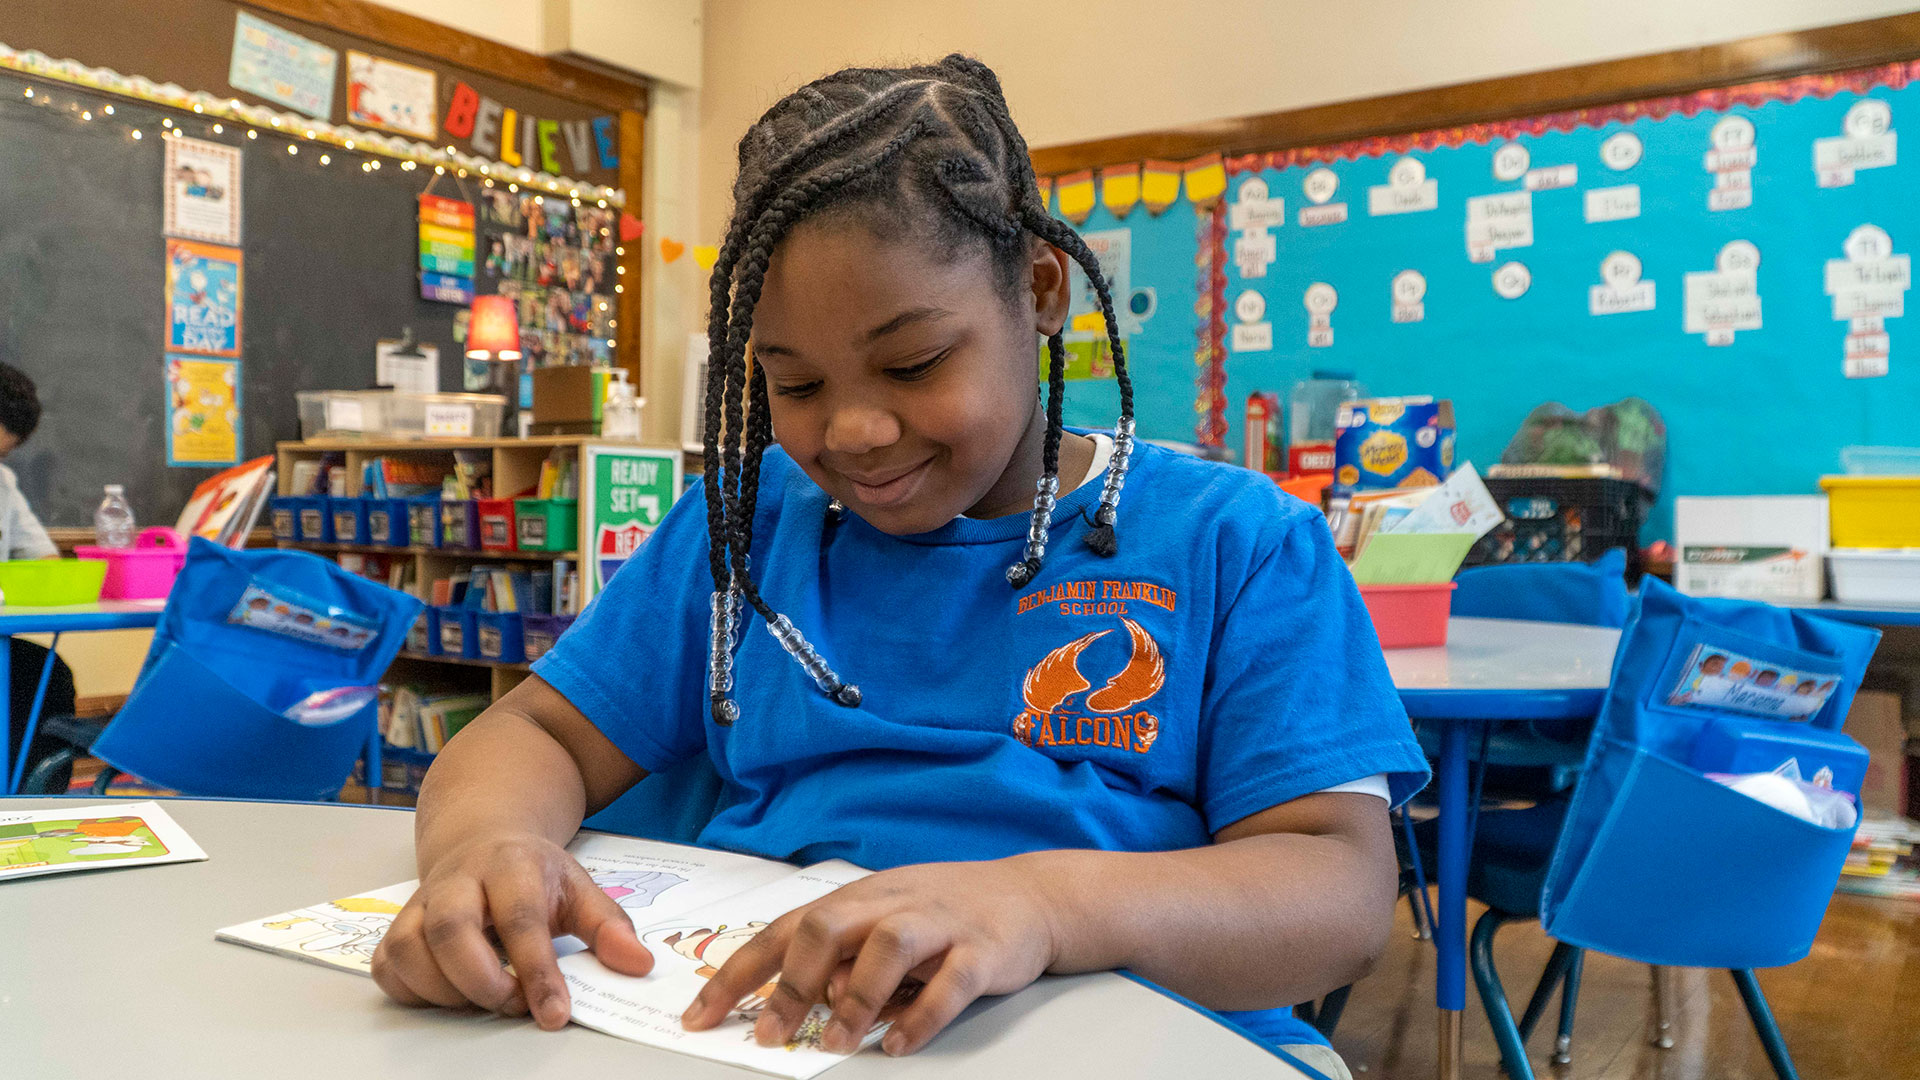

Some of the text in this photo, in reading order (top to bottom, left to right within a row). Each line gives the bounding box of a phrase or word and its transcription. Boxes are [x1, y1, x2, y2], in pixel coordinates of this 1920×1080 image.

[444, 81, 619, 174] BELIEVE
[173, 303, 235, 327] READ
[183, 330, 228, 352] DAY
[611, 459, 658, 485] READY
[610, 487, 639, 513] SET
[615, 531, 649, 553] REA
[1017, 580, 1177, 615] BENJAMIN FRANKLIN
[1060, 602, 1129, 616] SCHOOL
[1025, 707, 1152, 753] FALCONS
[574, 999, 607, 1014] storm
[598, 990, 640, 1008] strange
[639, 1004, 662, 1015] did
[620, 1015, 649, 1028] time
[654, 1025, 687, 1041] Every
